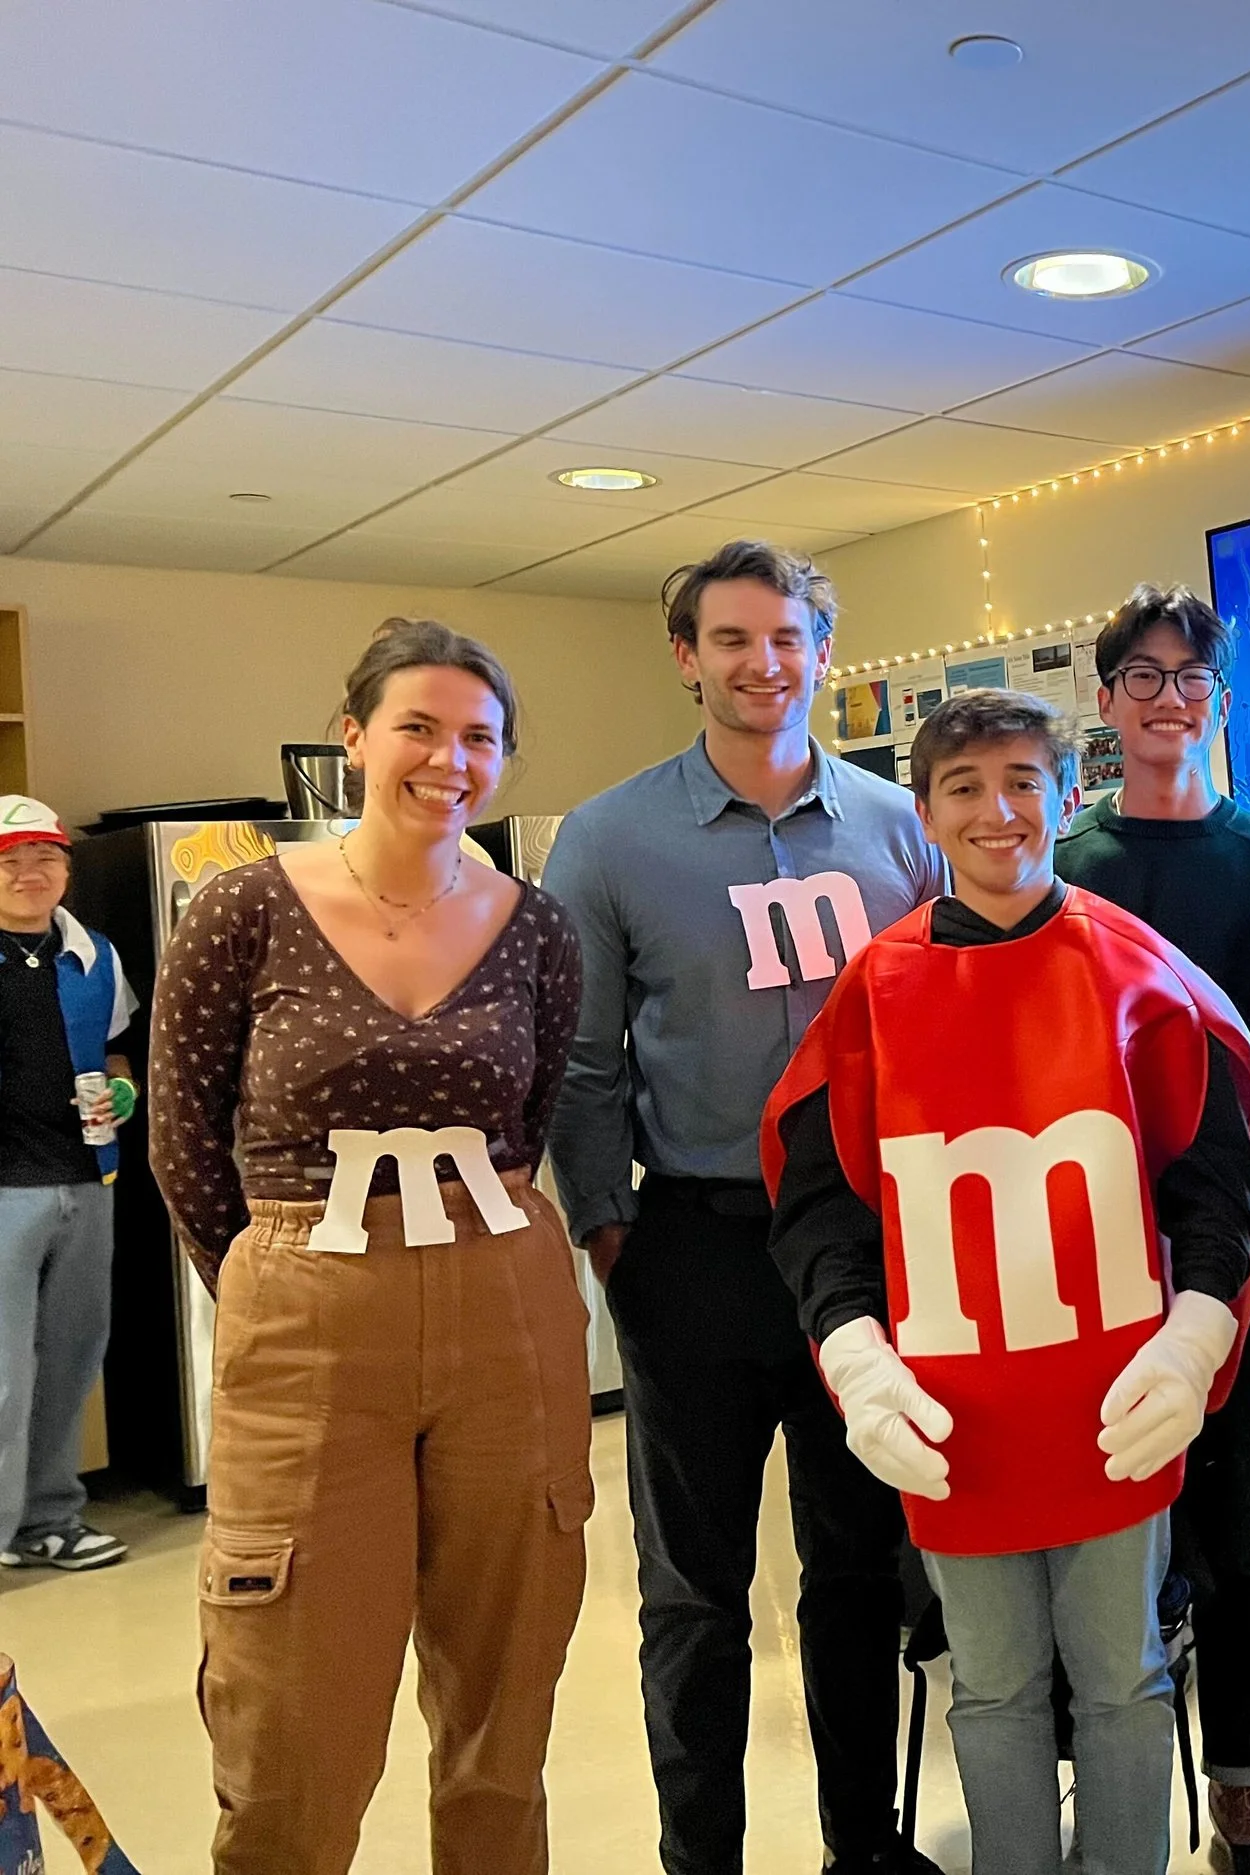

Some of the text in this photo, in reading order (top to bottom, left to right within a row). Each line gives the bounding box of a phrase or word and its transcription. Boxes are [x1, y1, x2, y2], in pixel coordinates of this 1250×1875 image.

[728, 871, 873, 990] m
[306, 1126, 531, 1254] m
[879, 1109, 1163, 1357] m
